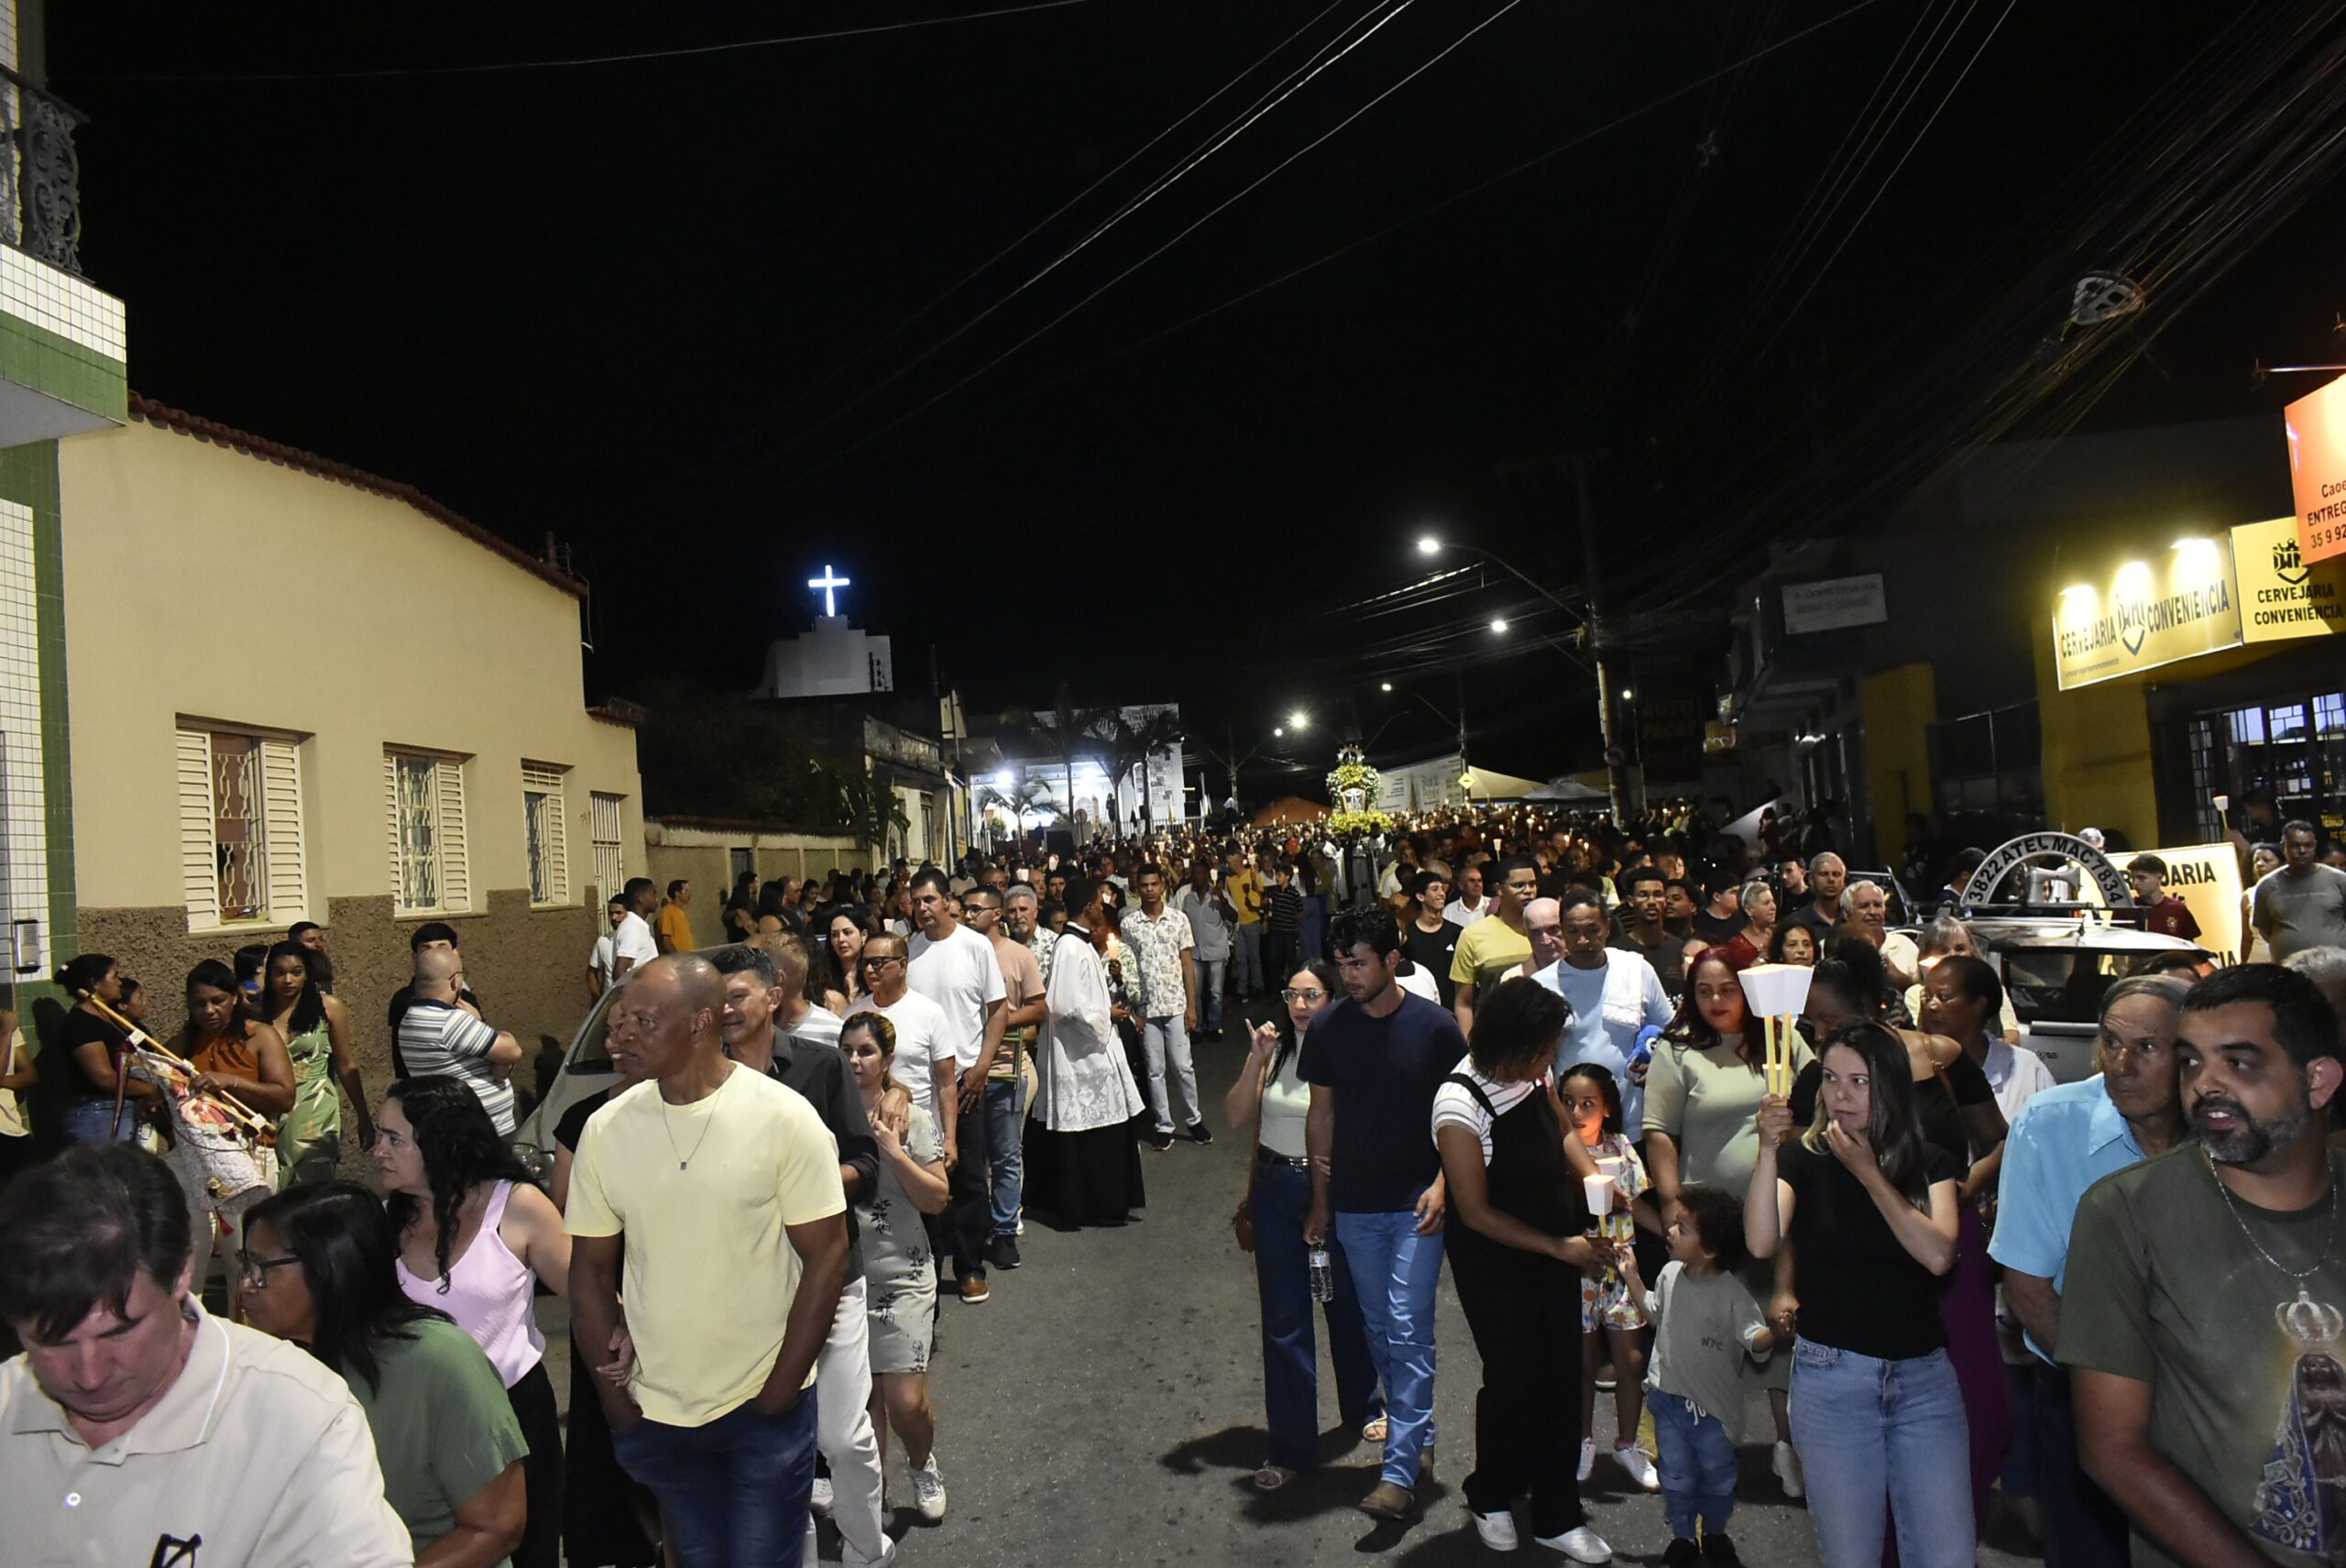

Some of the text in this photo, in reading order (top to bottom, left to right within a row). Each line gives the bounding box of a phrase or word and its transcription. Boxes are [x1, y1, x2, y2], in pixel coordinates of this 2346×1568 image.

[2310, 532, 2323, 549] 35
[2326, 529, 2332, 543] 9
[2257, 583, 2335, 604] CERVEJARIA
[2254, 603, 2344, 626] CONVENIÊNCIA
[1701, 1336, 1724, 1352] NYC
